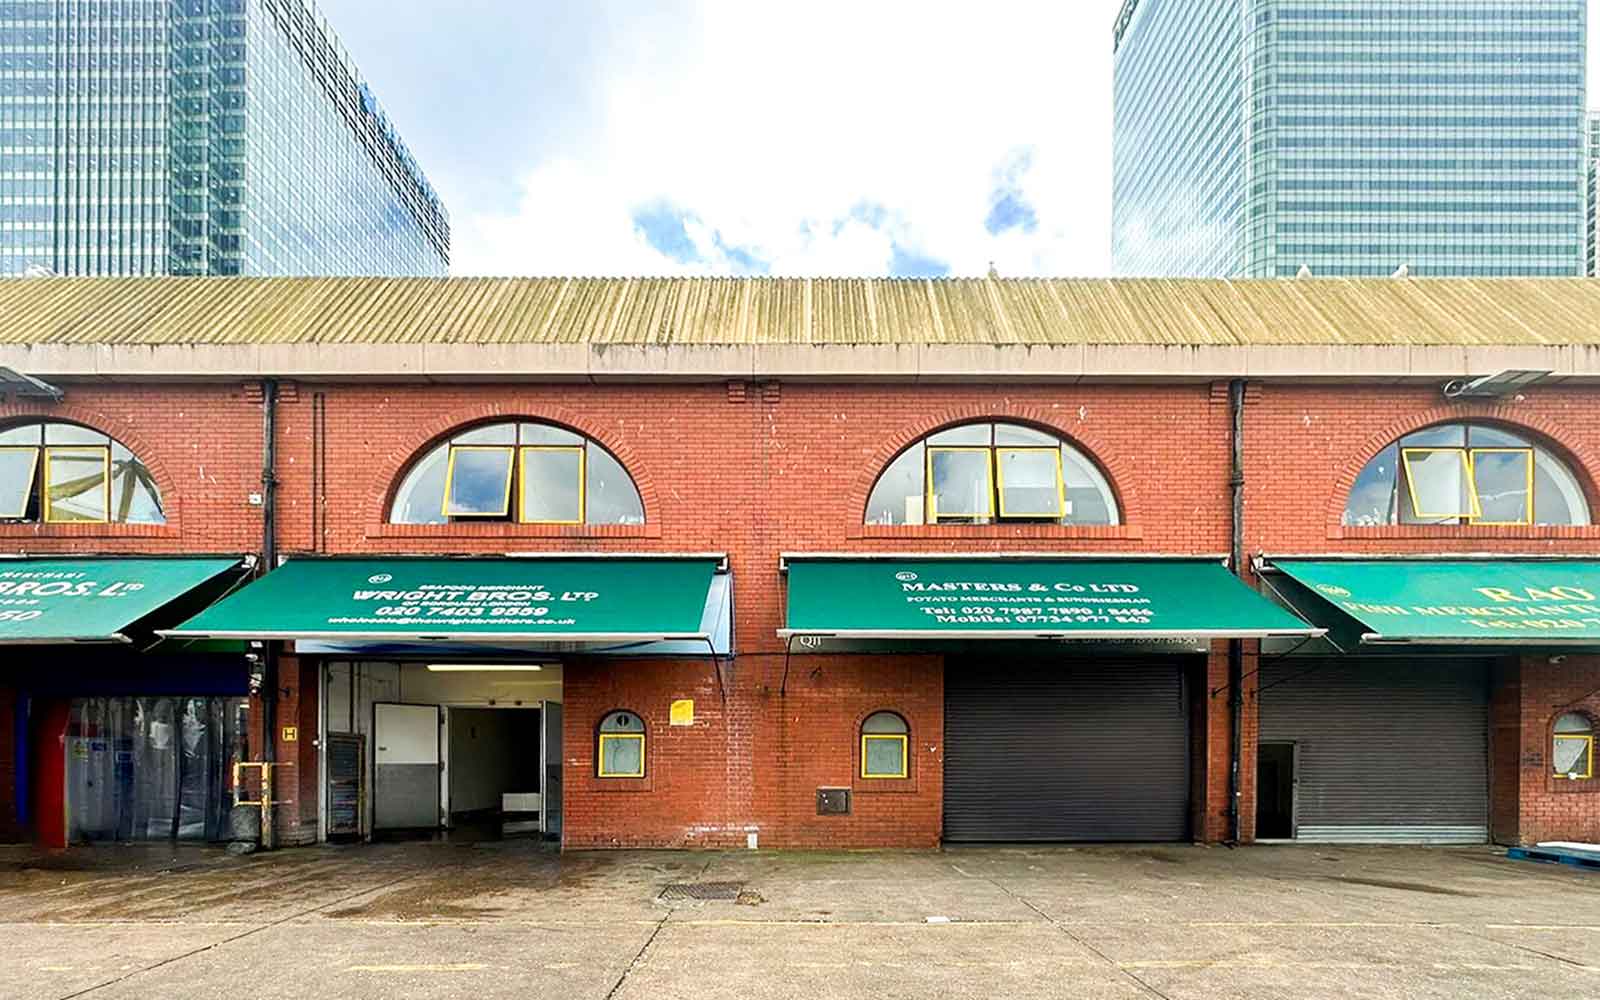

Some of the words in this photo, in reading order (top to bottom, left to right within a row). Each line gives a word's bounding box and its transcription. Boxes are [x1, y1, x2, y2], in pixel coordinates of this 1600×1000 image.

[902, 582, 1022, 592] MASTERS
[1028, 583, 1049, 593] &
[1053, 583, 1086, 593] Co
[1089, 583, 1139, 593] LTD
[352, 590, 465, 601] WRIGHT
[466, 591, 556, 601] BROS.
[560, 592, 599, 602] LTD
[1475, 586, 1595, 601] RAO
[375, 606, 421, 616] 020
[426, 607, 485, 617] 7403
[919, 606, 956, 616] Tel:
[961, 607, 996, 616] 020
[998, 607, 1042, 616] 7987
[935, 615, 1011, 624] Mobile:
